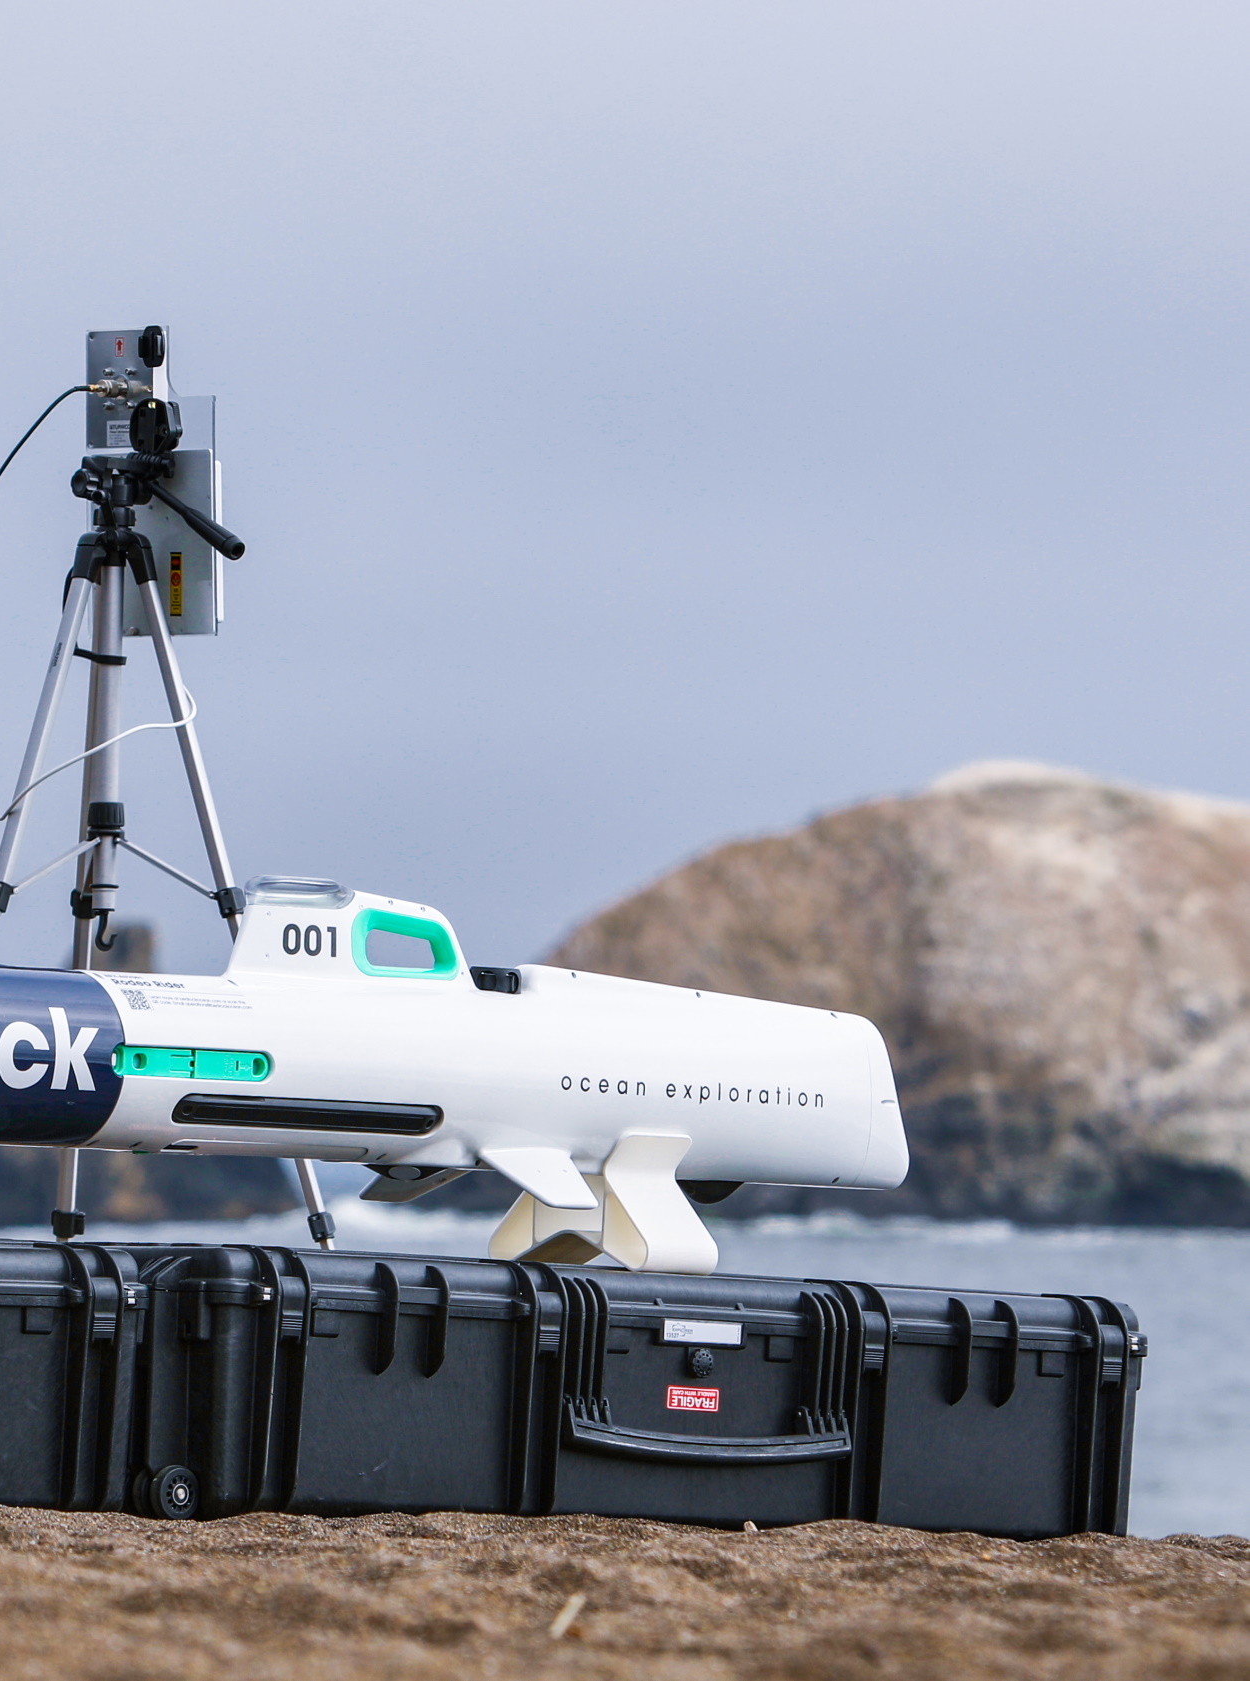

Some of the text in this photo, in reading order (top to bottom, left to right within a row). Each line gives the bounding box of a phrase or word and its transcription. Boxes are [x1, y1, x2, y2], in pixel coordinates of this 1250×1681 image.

[282, 923, 337, 958] 001
[111, 978, 186, 989] Rodeo Rider
[561, 1075, 824, 1108] ocean exploration
[671, 1396, 715, 1408] FRAGILE
